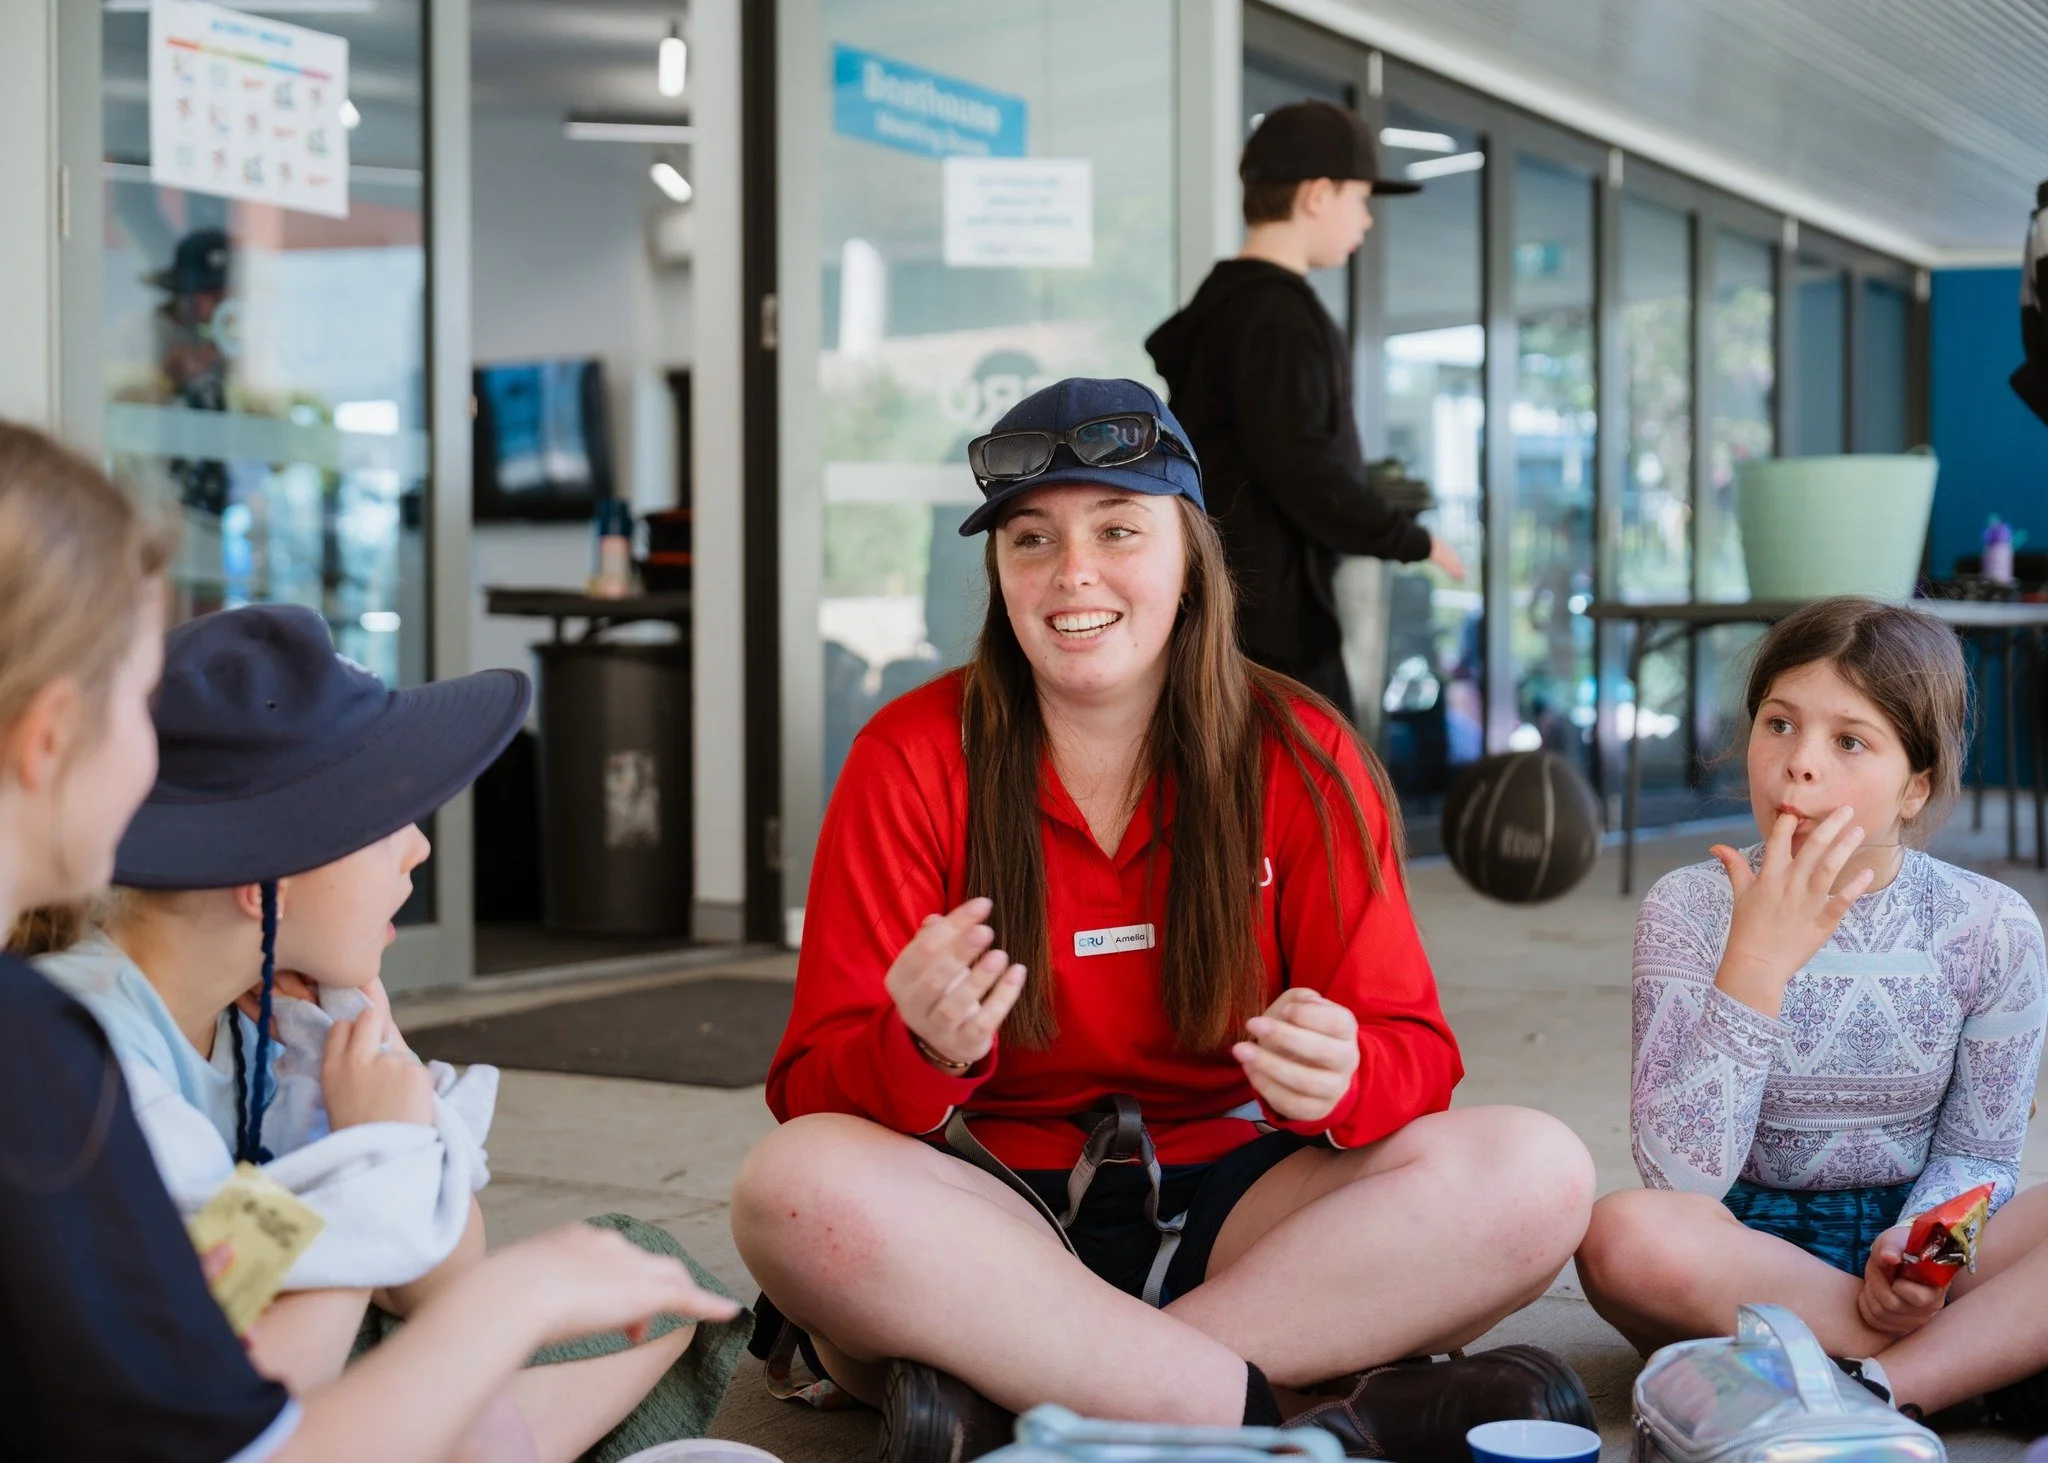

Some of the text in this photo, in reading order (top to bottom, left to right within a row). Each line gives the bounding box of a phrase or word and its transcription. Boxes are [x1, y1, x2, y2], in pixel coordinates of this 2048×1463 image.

[864, 60, 1000, 135] Boathouse
[1078, 933, 1145, 947] CRU Amelia
